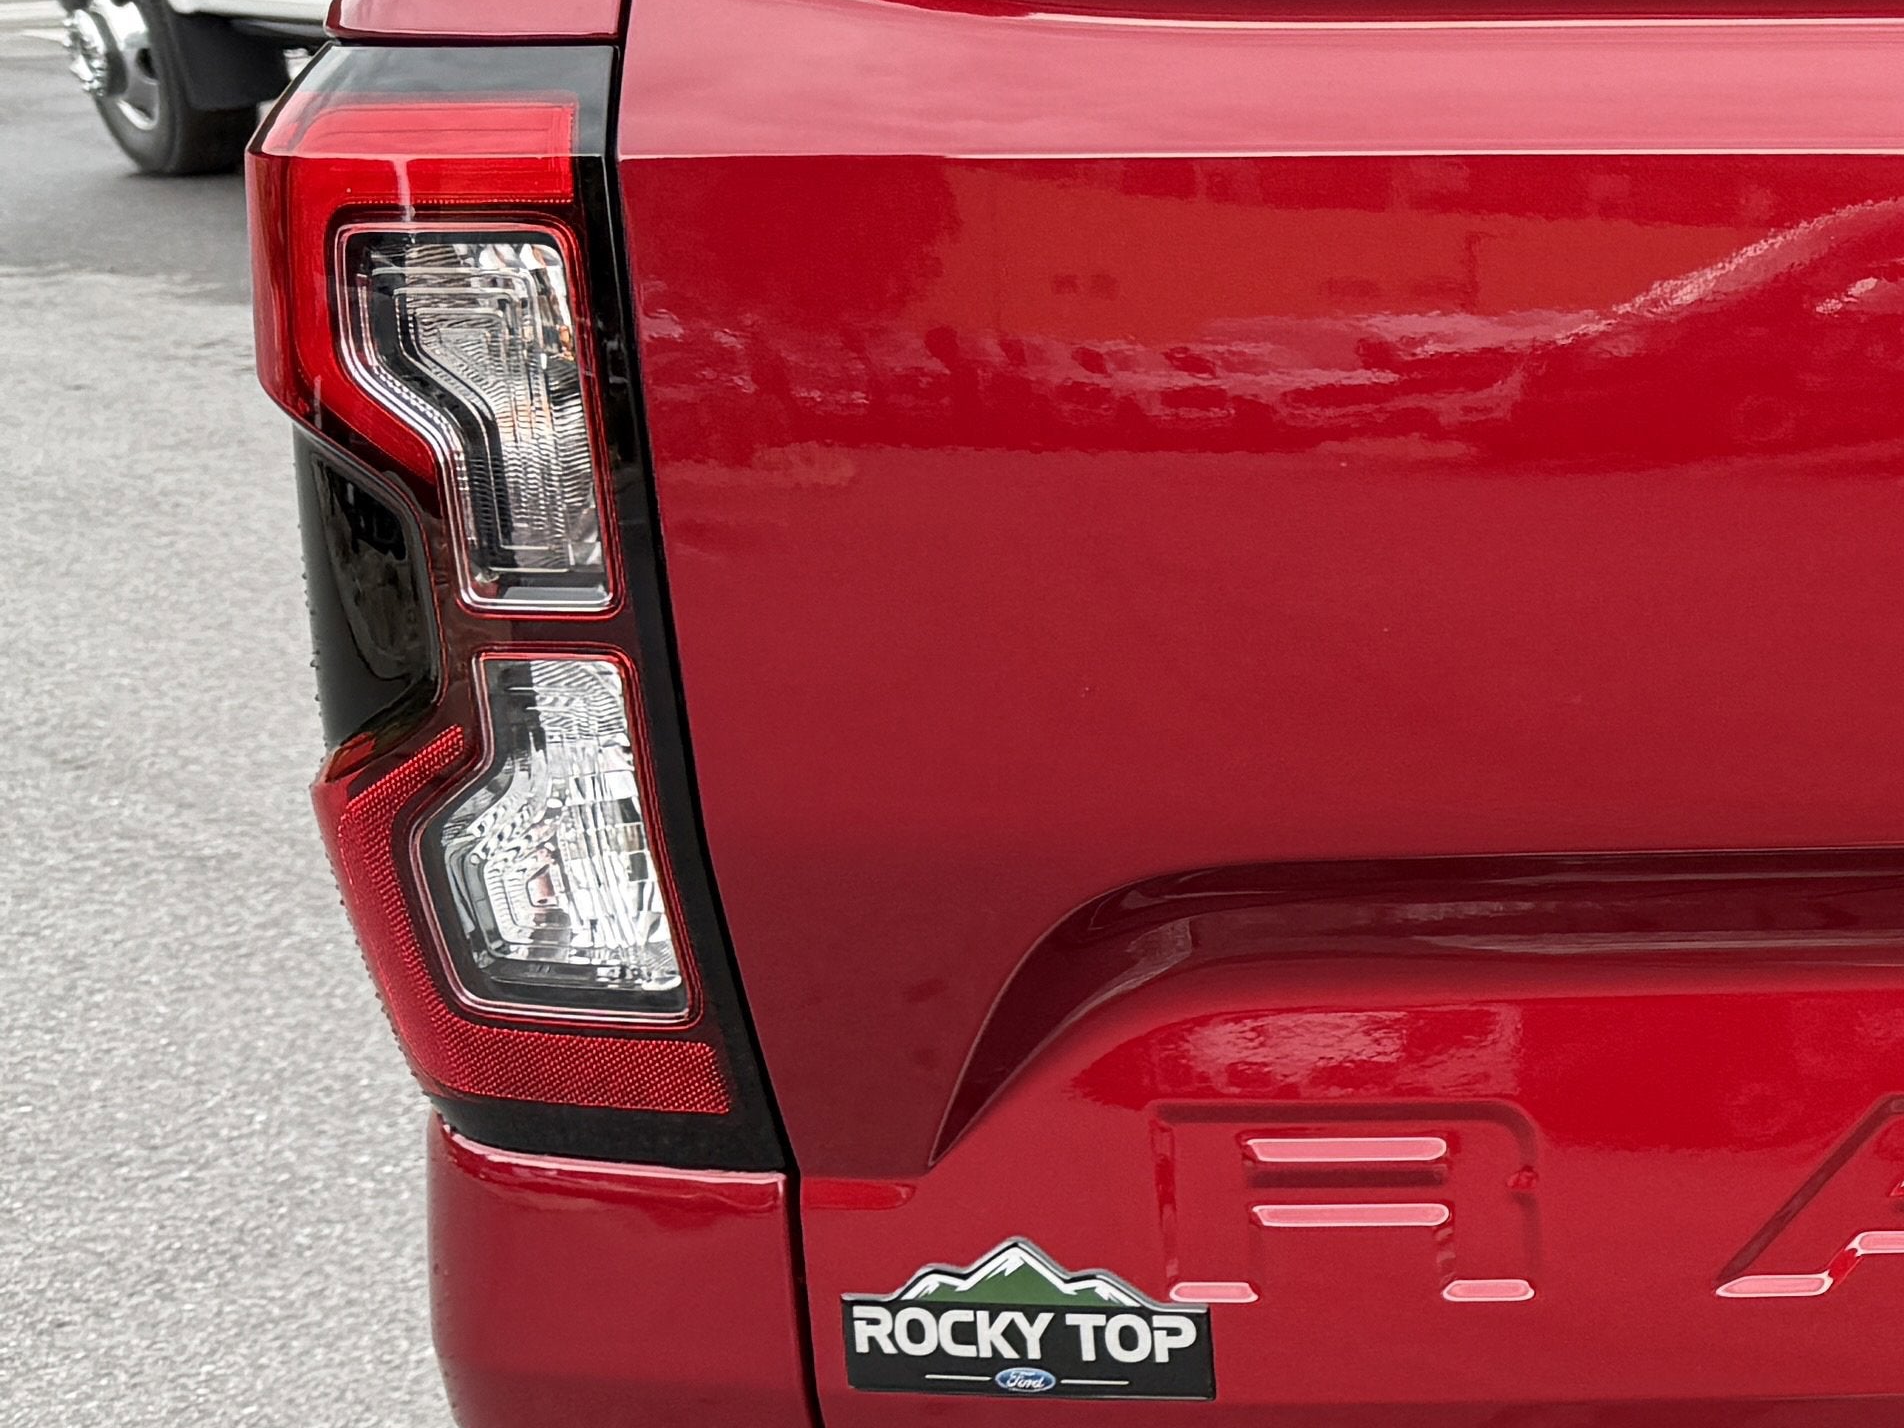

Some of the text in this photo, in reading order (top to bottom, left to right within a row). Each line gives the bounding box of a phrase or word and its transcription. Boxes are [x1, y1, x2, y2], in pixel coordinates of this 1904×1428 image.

[853, 1306, 1197, 1362] ROCKY TOP
[1006, 1370, 1047, 1390] Ford
